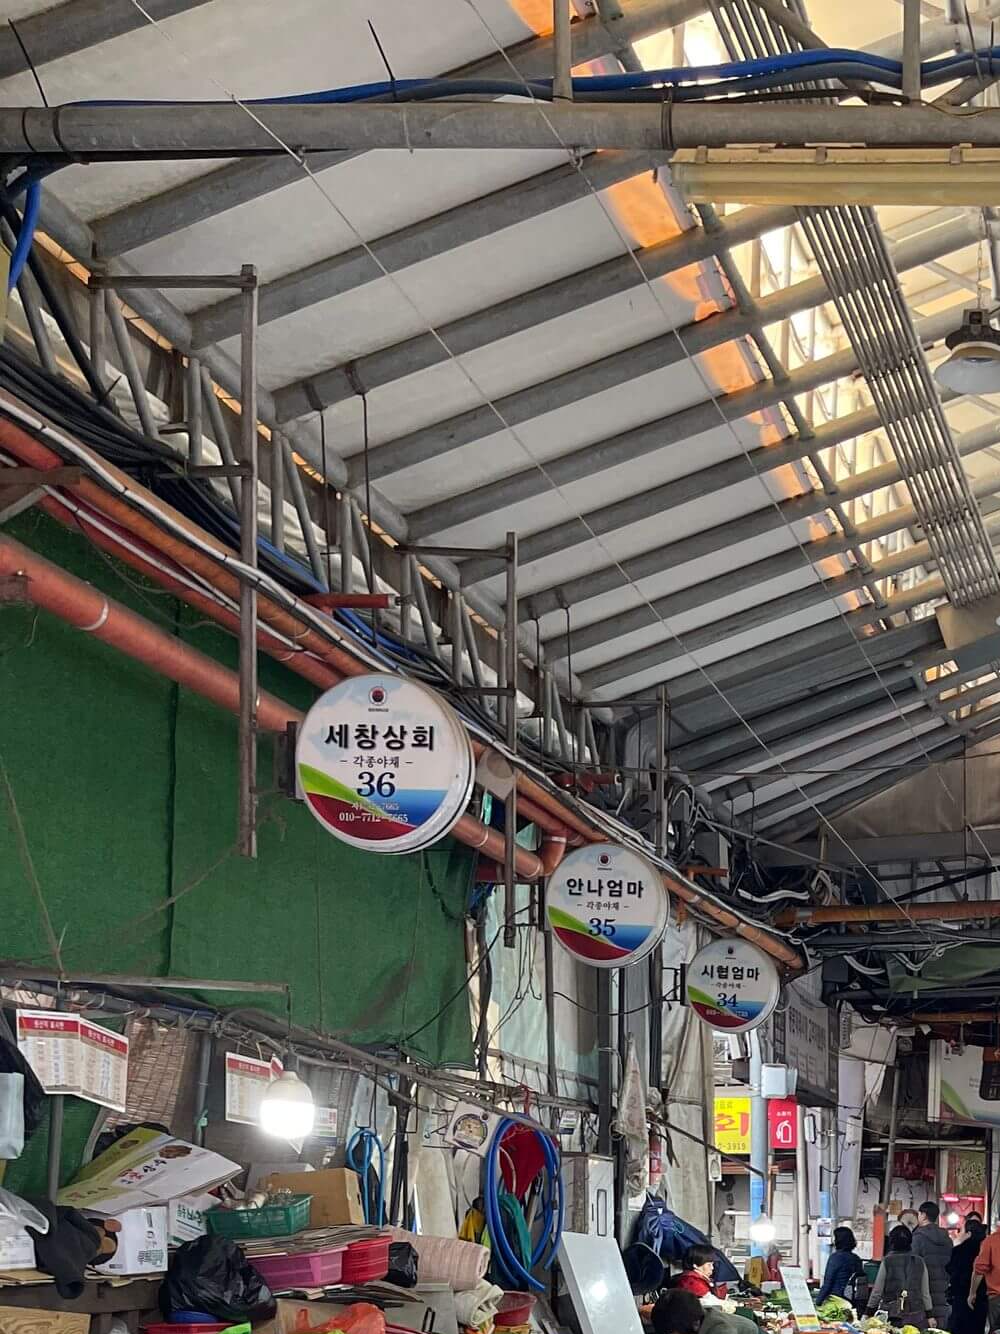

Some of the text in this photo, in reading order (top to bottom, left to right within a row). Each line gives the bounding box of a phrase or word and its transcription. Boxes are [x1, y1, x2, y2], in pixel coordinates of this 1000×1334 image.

[324, 724, 434, 750] 세창상회
[353, 755, 400, 768] 각종야채
[356, 771, 396, 798] 36
[566, 878, 644, 898] 안나엄마
[588, 917, 616, 937] 35
[717, 993, 737, 1008] 34
